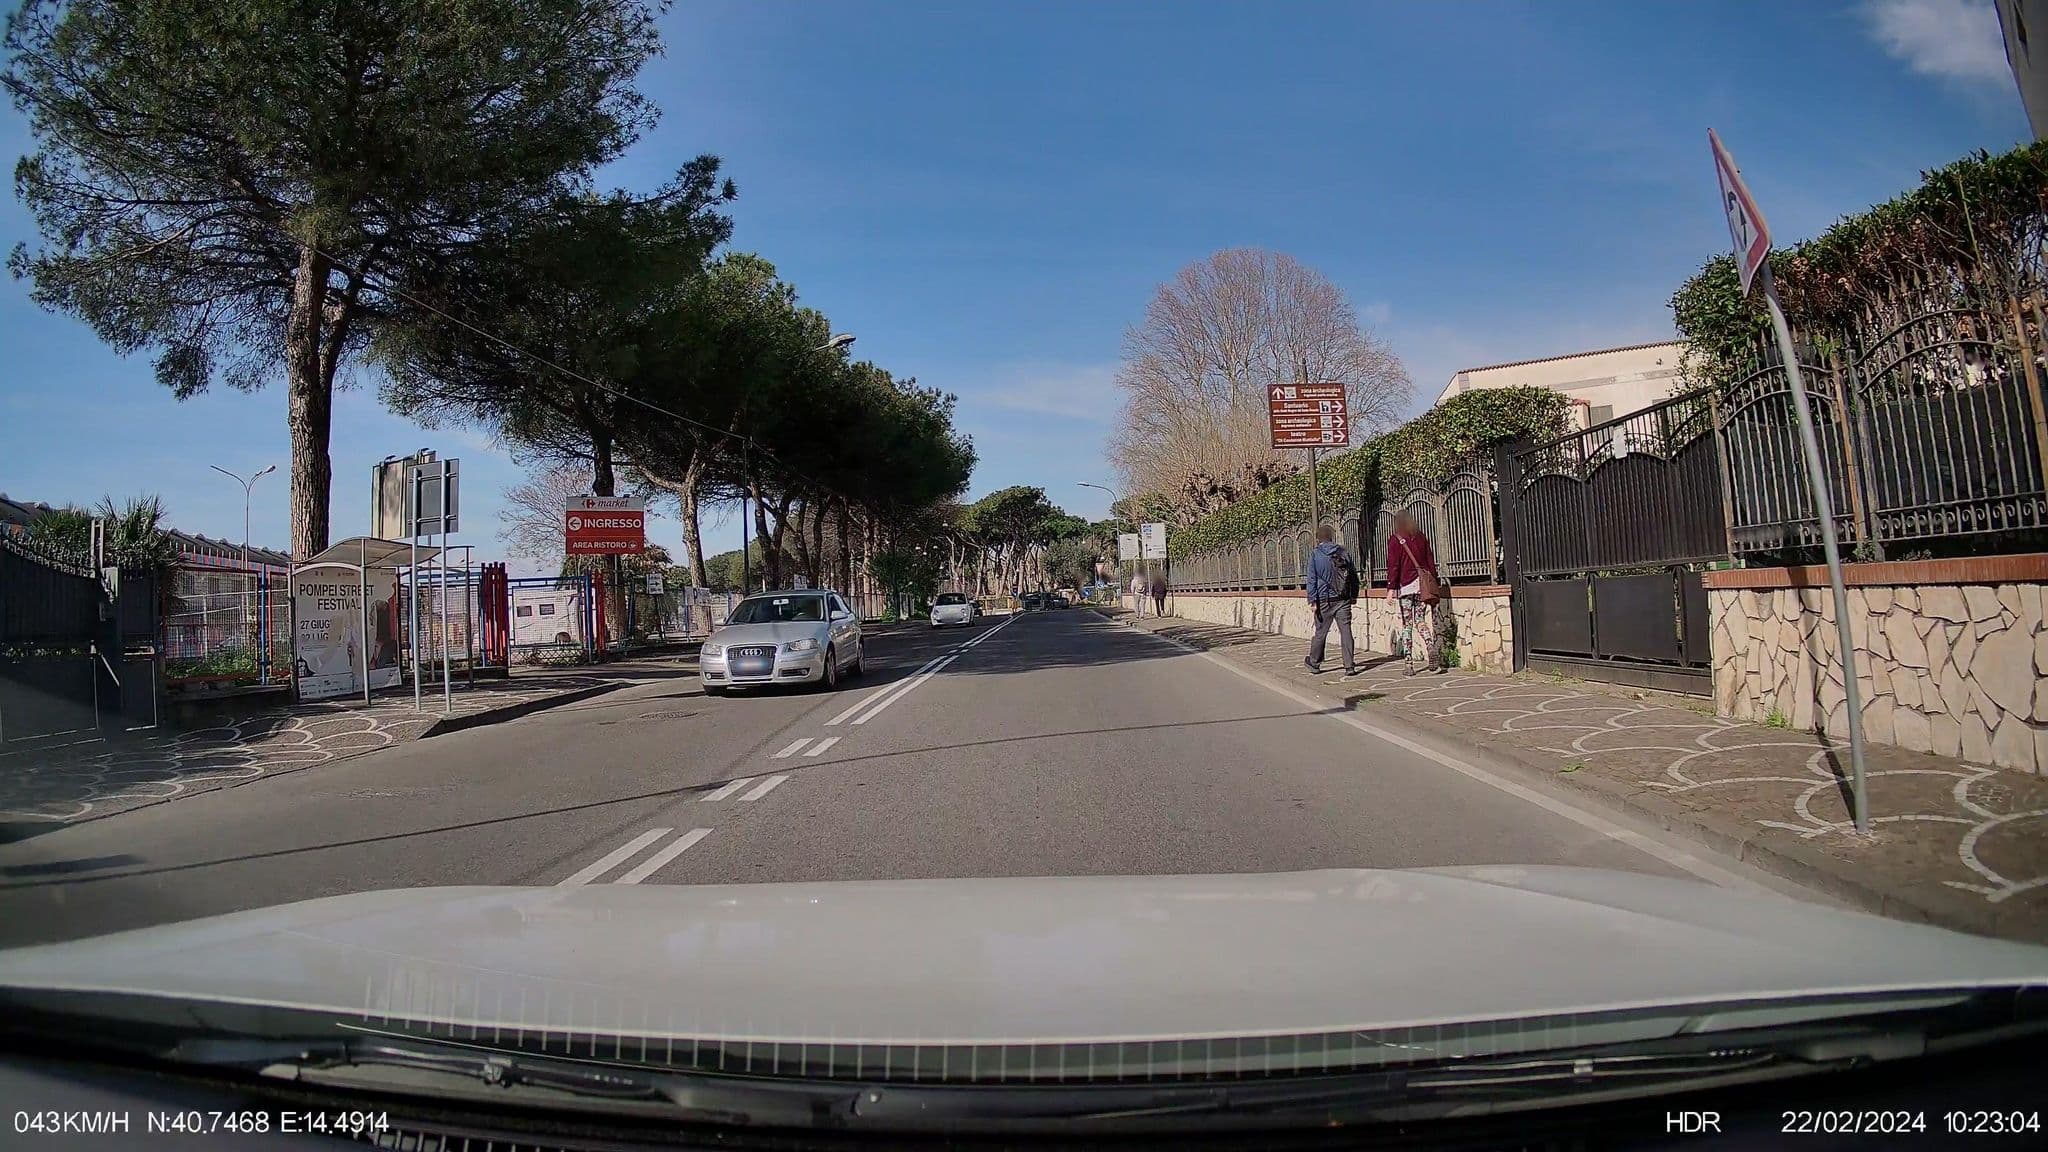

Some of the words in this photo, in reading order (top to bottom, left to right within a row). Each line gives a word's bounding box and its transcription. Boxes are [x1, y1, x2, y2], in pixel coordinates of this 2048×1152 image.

[598, 499, 629, 508] market
[584, 518, 642, 529] INGRESSO
[572, 541, 593, 549] AREA
[593, 541, 627, 549] RISTORO
[299, 584, 337, 597] POMPEI
[339, 584, 374, 597] STREET
[317, 598, 362, 611] FESTIVAL
[300, 620, 310, 630] 27
